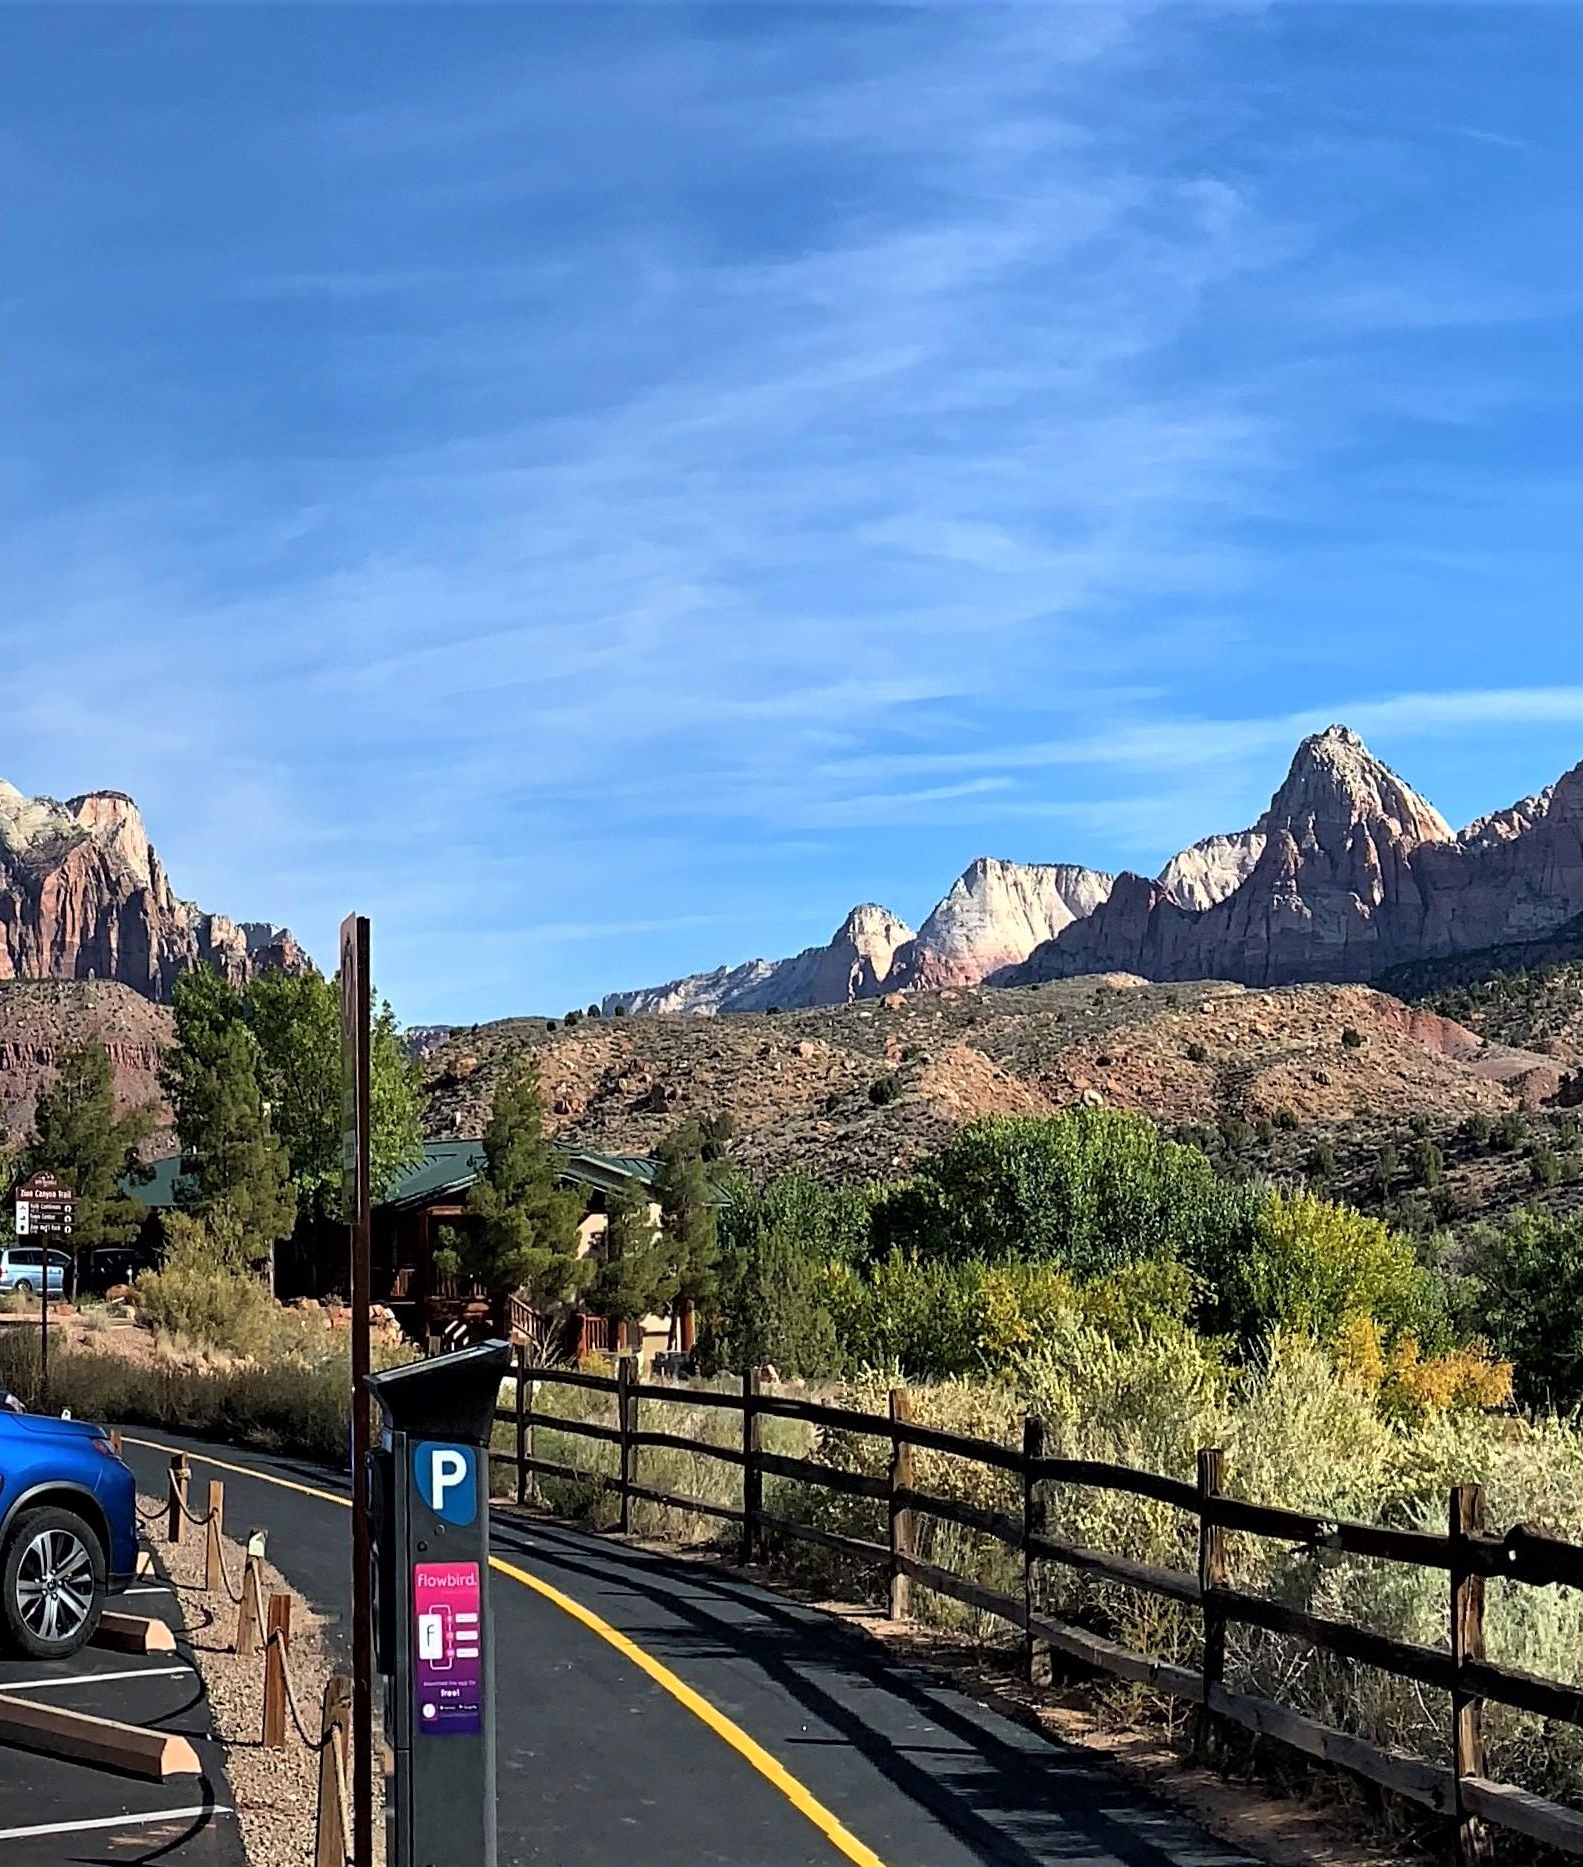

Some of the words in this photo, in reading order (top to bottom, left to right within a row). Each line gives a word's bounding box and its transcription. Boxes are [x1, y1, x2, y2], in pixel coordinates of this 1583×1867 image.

[35, 1189, 56, 1199] Canyon
[58, 1189, 72, 1199] Trail
[432, 1450, 467, 1510] P
